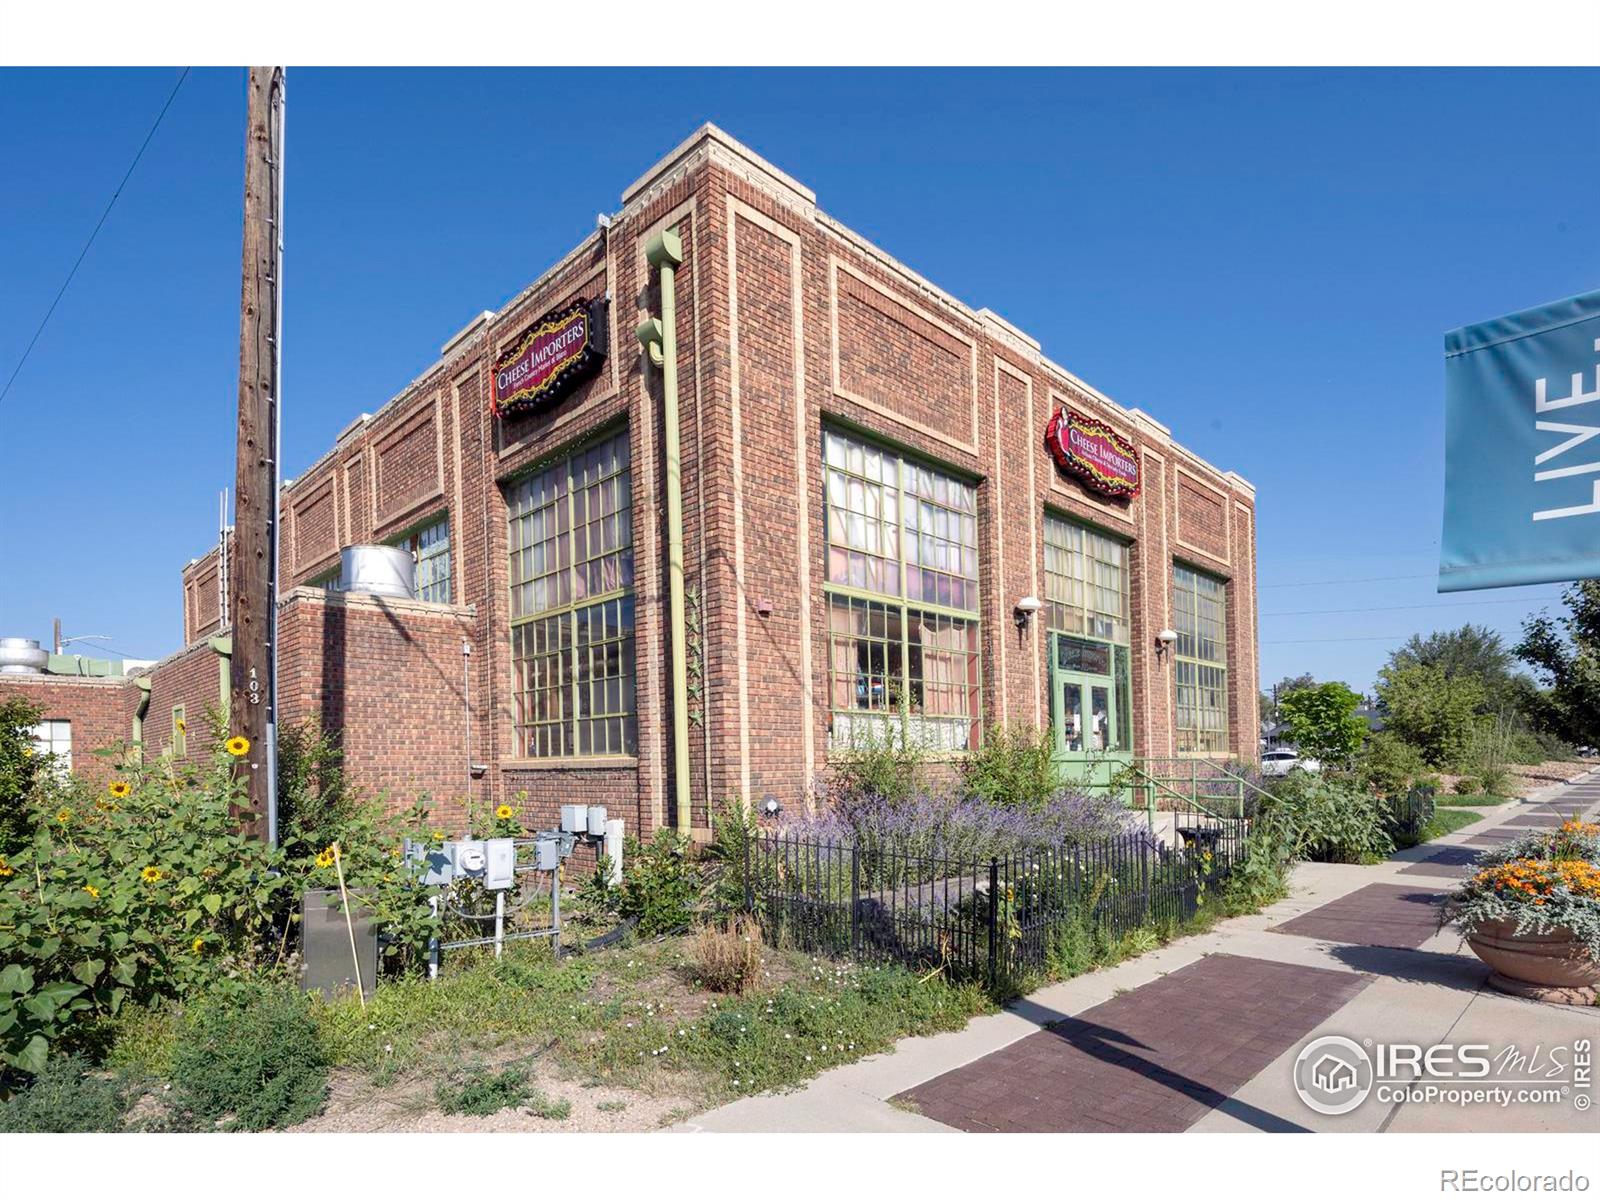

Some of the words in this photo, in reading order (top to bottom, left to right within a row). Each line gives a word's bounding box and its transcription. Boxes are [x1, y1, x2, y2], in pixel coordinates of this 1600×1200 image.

[498, 358, 529, 390] CHEESE
[531, 320, 584, 369] IMPORTERS
[1070, 428, 1098, 456] CHEESE
[1099, 444, 1136, 476] IMPORTERS
[249, 667, 260, 705] 103
